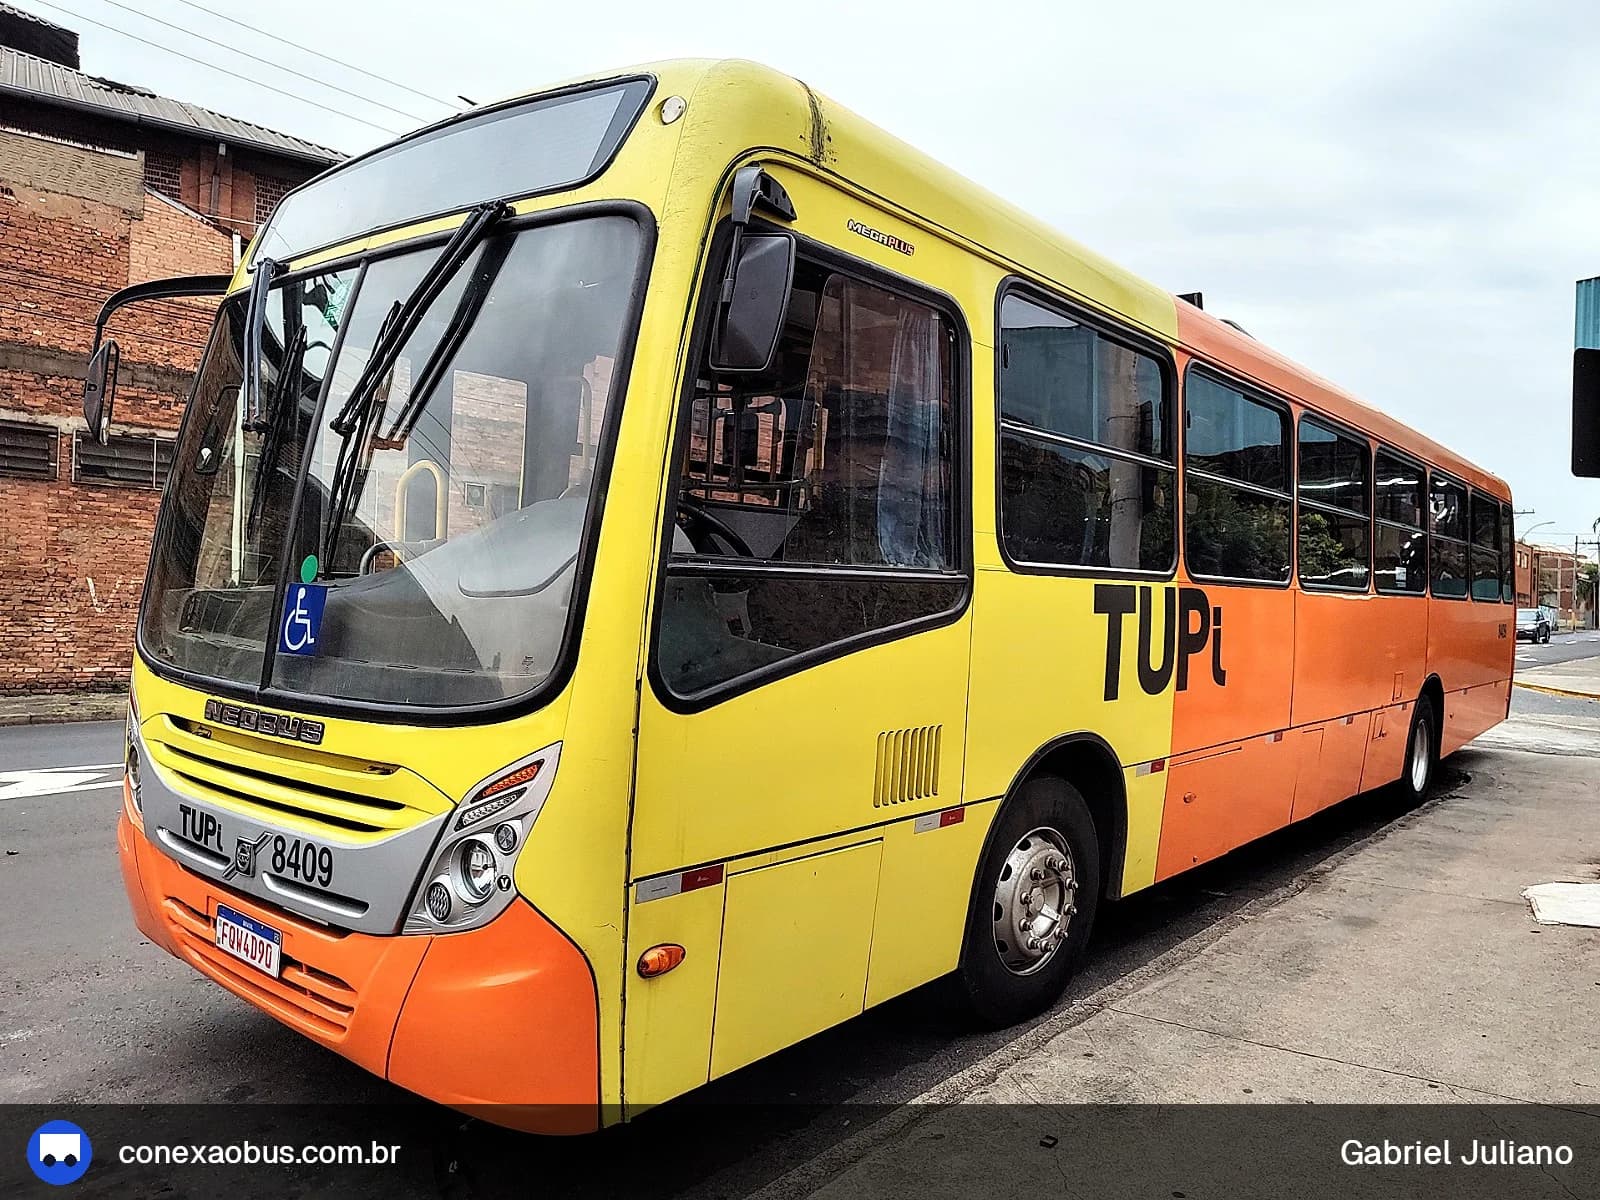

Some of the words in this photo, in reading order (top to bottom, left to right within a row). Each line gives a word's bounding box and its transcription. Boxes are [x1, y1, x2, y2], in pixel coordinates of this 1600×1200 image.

[846, 218, 915, 256] MEGAPLUS
[204, 699, 326, 745] NEOBUS
[271, 834, 333, 888] 8409
